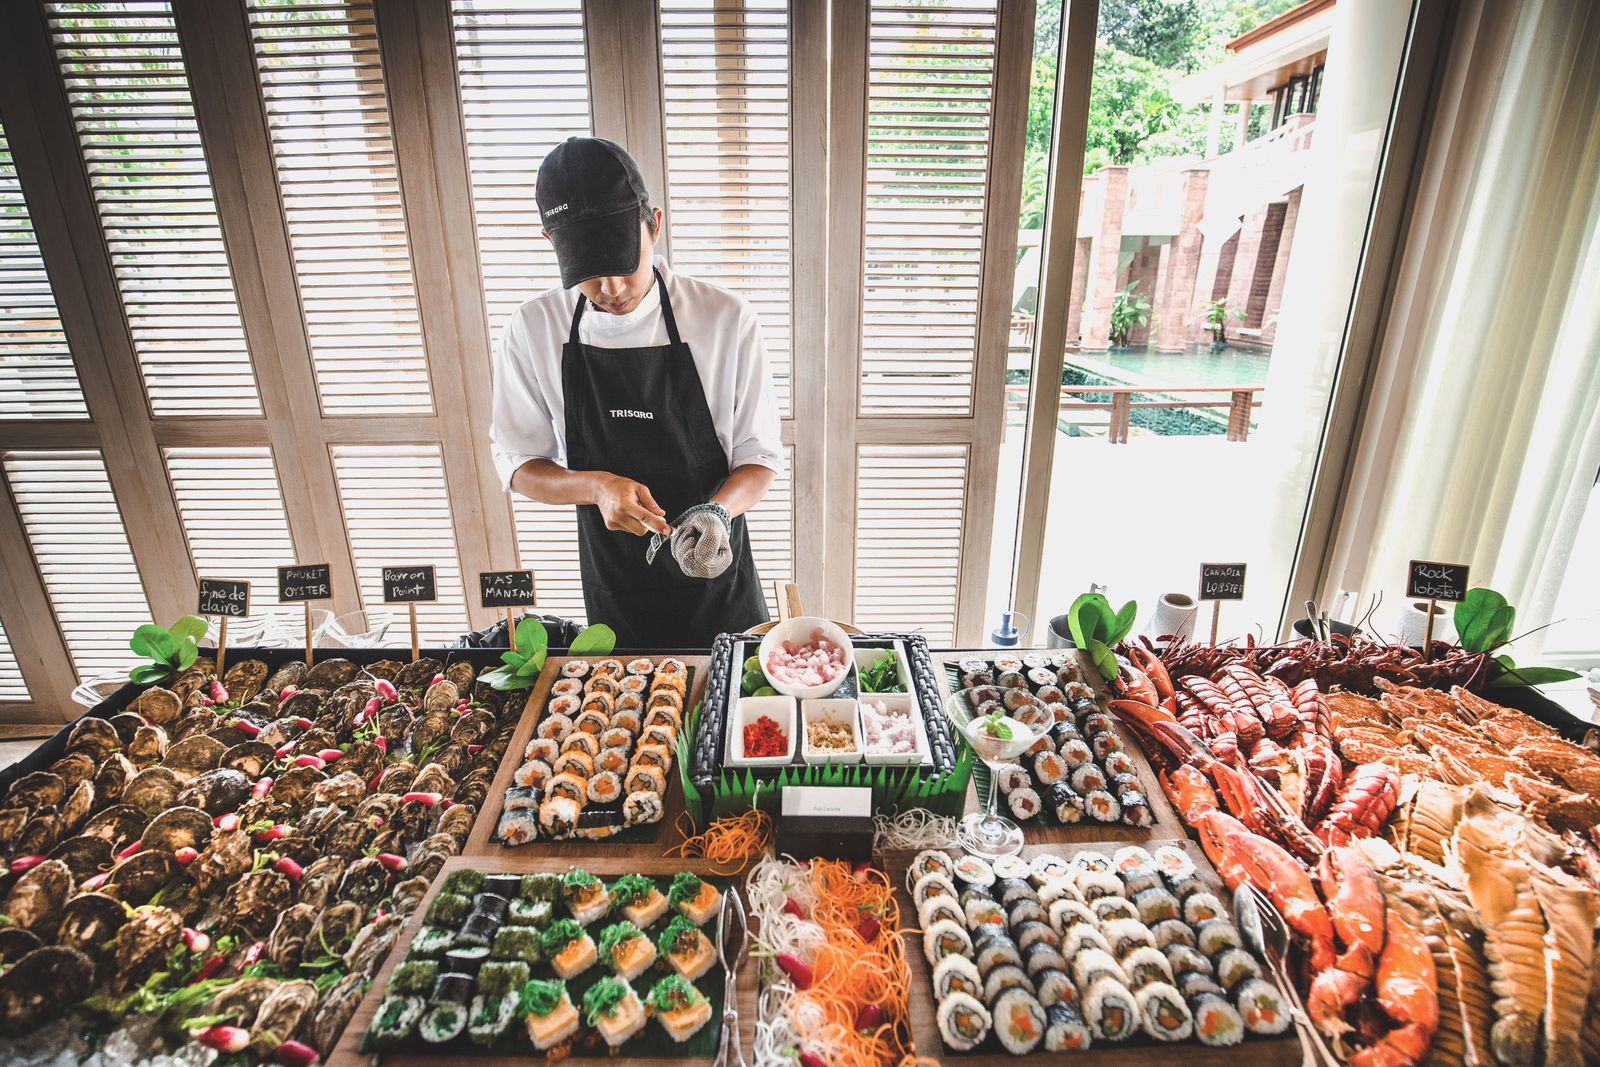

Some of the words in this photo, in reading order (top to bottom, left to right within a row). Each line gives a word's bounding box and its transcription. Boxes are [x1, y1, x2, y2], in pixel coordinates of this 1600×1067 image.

[286, 568, 325, 580] PHUKET
[1414, 564, 1454, 582] Rock
[228, 585, 246, 601] de
[284, 583, 329, 598] OYSTER
[1414, 580, 1462, 599] lobster
[201, 598, 244, 616] claire
